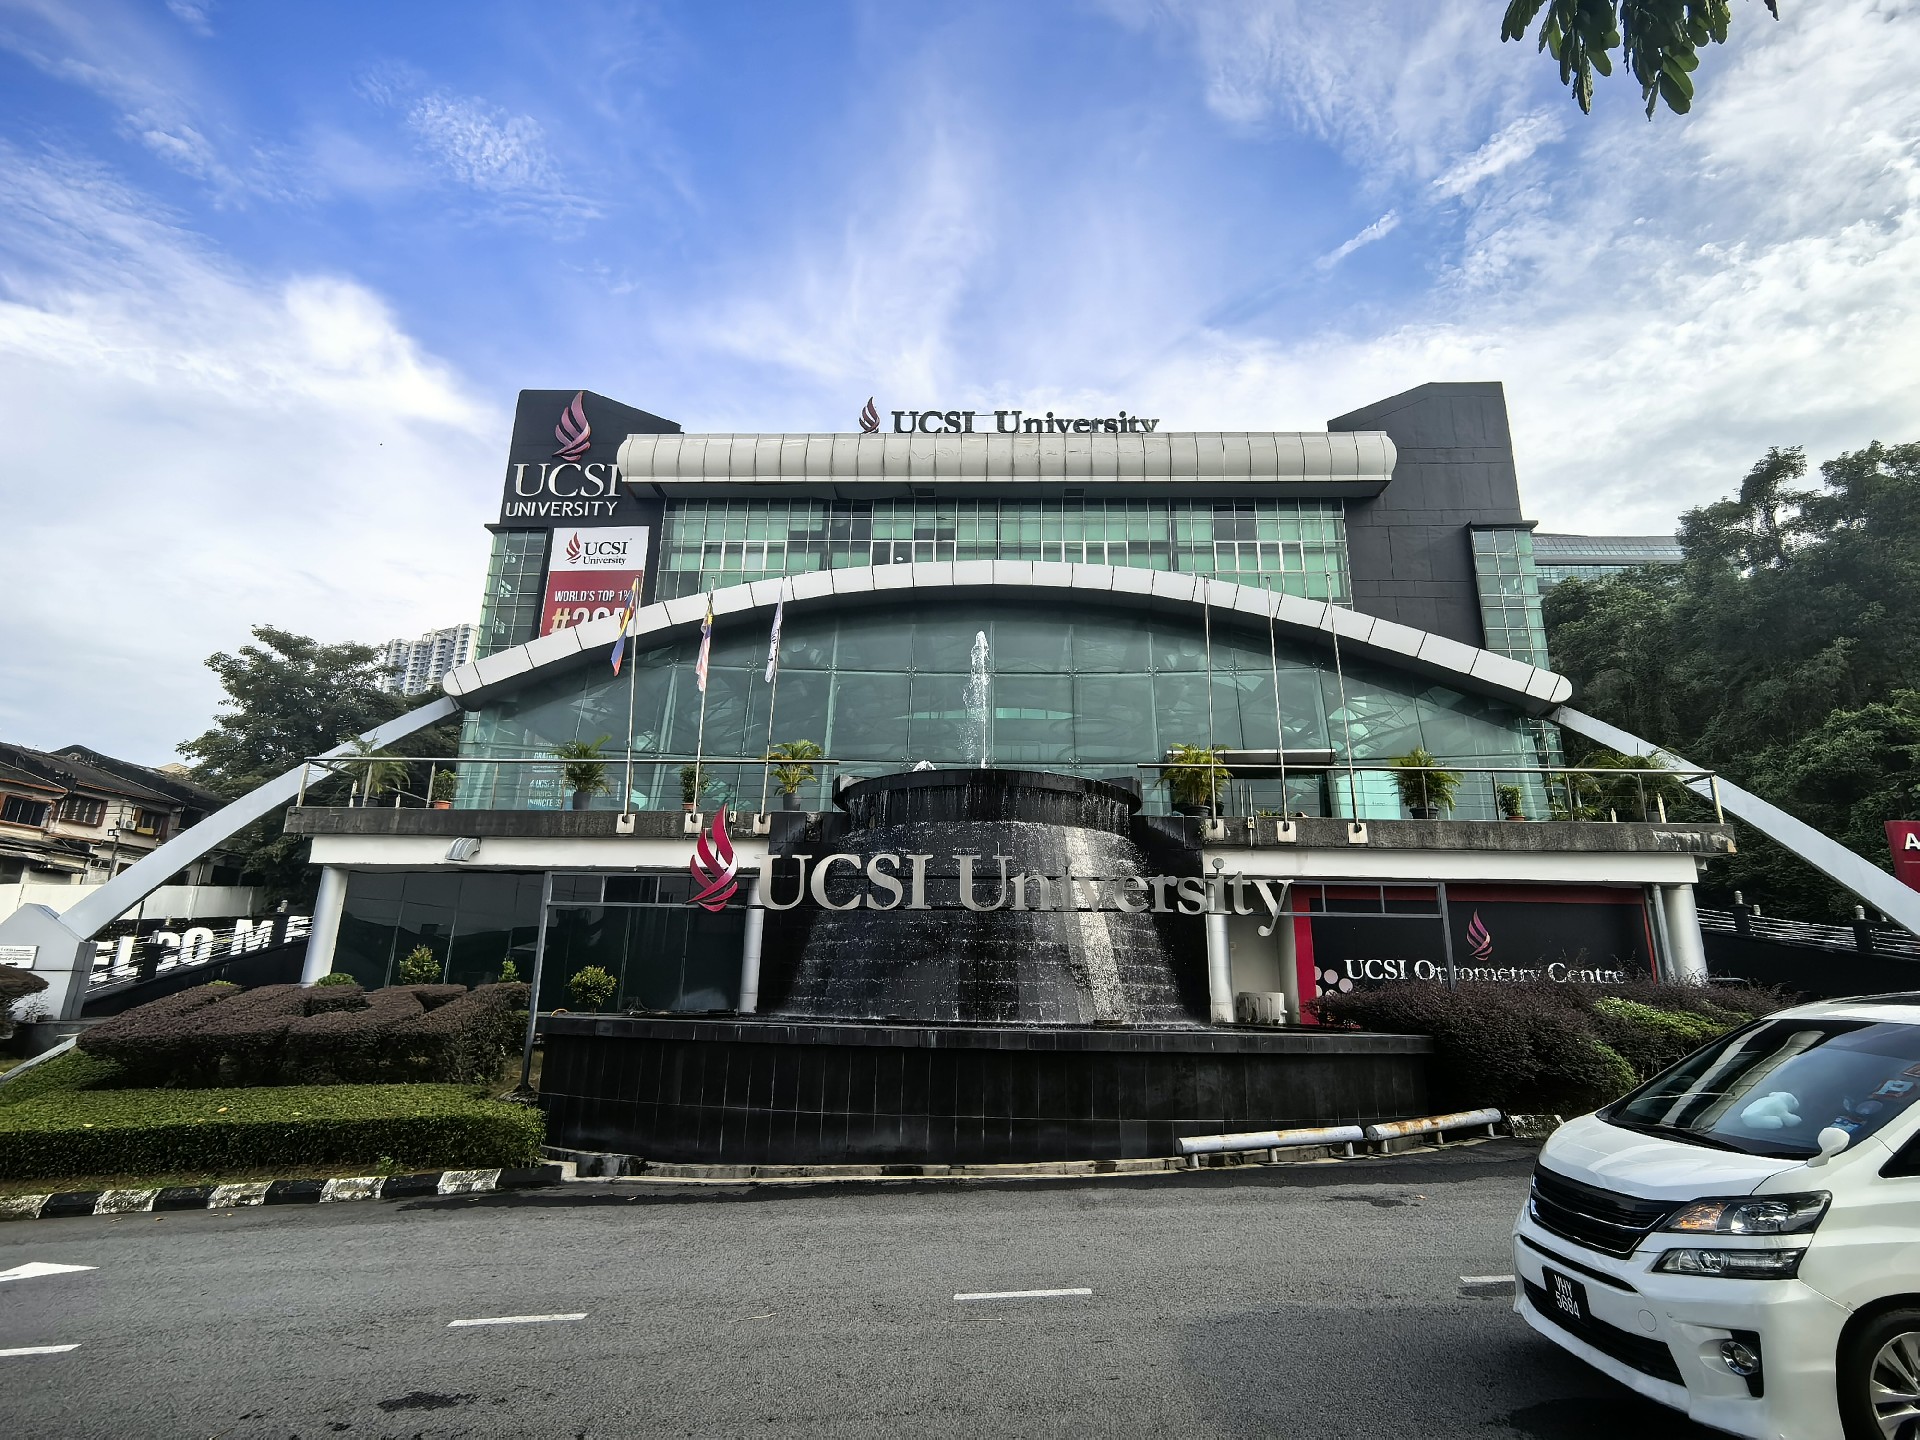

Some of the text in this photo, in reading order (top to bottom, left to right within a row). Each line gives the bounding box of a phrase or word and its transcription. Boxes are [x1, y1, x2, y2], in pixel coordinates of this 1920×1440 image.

[891, 411, 1160, 434] UCSI University
[513, 463, 621, 497] UCSI
[505, 501, 618, 517] UNIVERSITY
[584, 541, 629, 555] UCSI
[583, 556, 627, 566] University
[554, 590, 595, 602] WORLD'S
[597, 590, 615, 602] TOP
[756, 853, 1295, 937] UCSI University
[1344, 959, 1408, 980] UCSI
[1548, 962, 1626, 985] Centre
[1554, 1274, 1573, 1298] VHY
